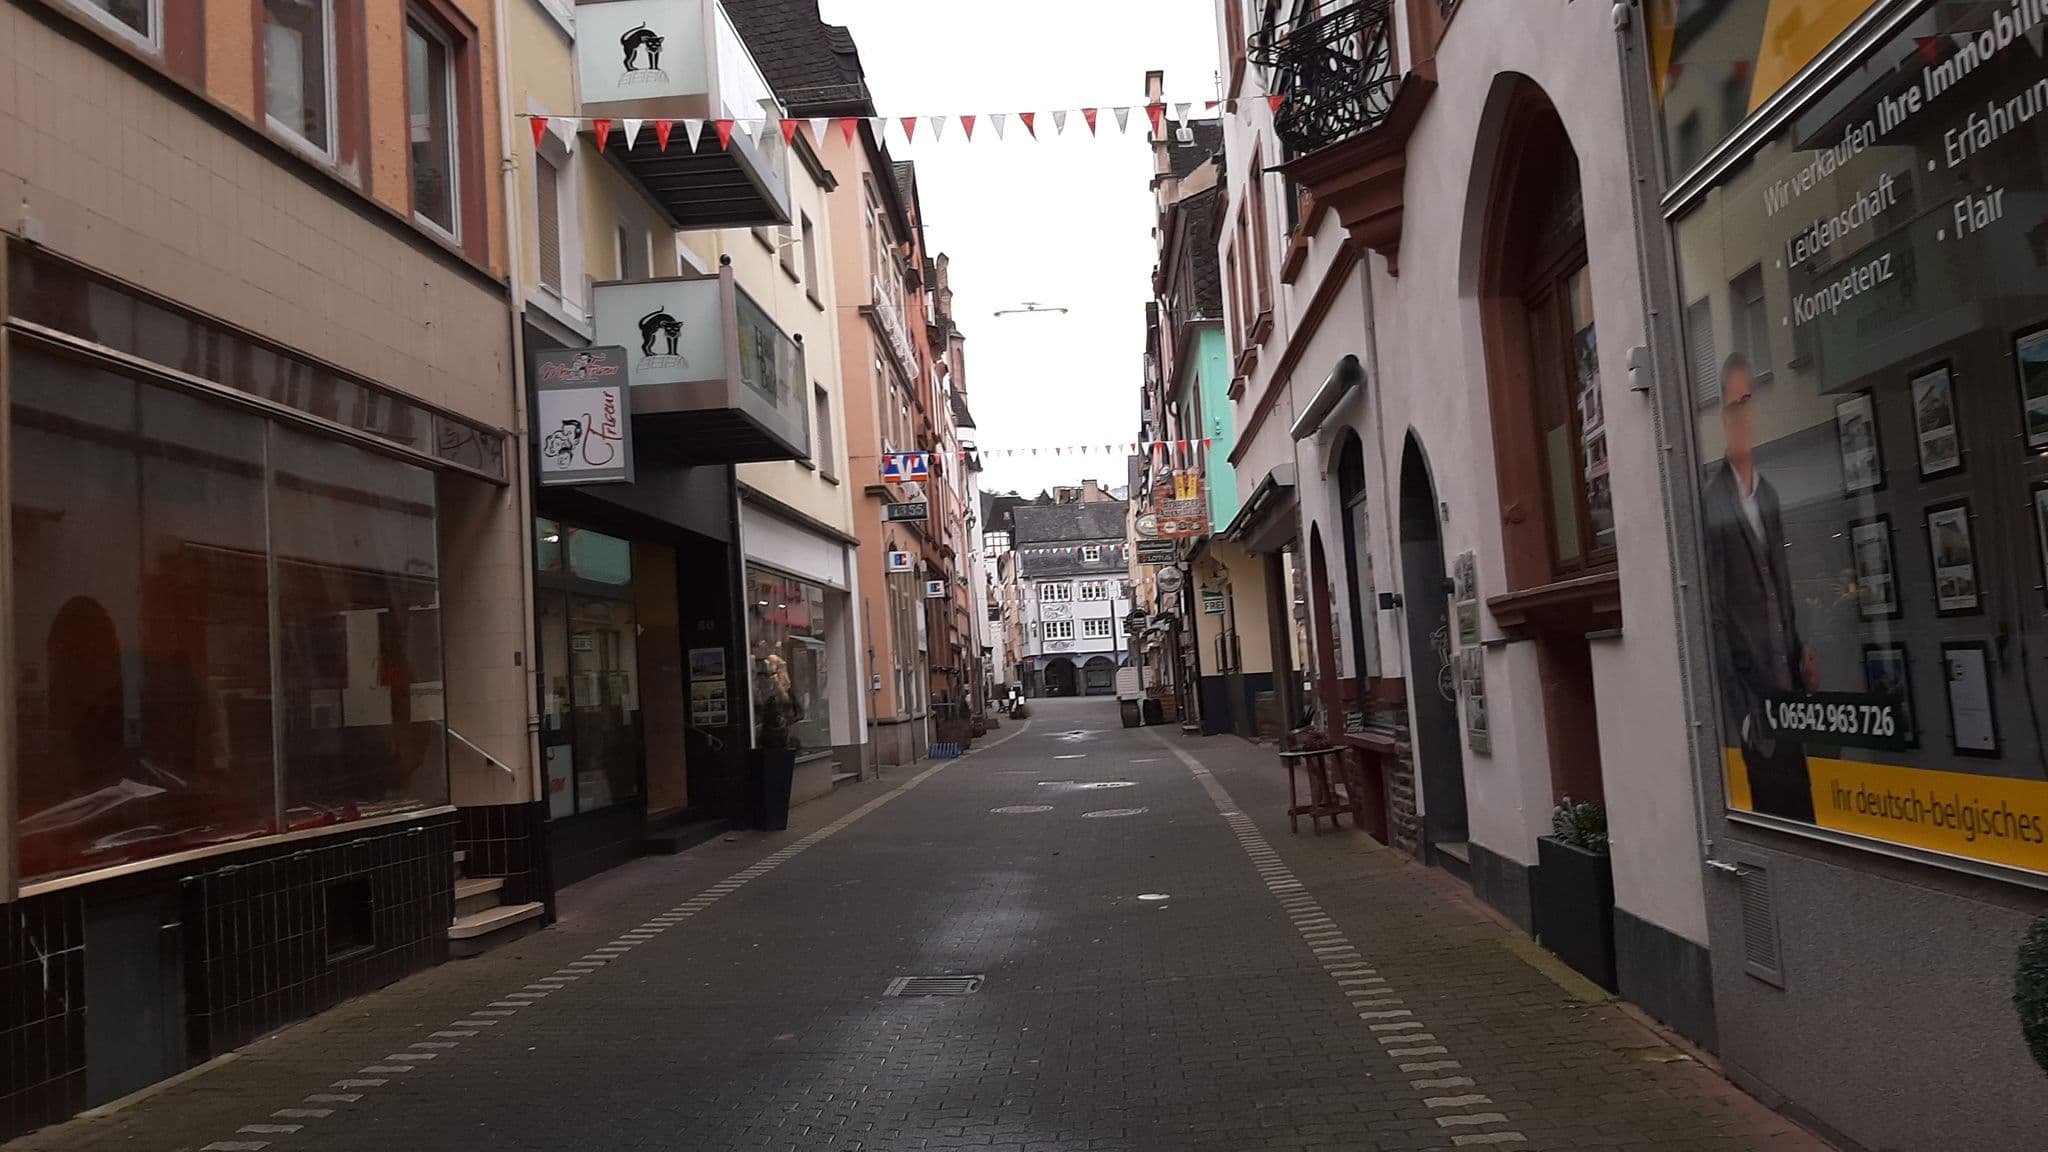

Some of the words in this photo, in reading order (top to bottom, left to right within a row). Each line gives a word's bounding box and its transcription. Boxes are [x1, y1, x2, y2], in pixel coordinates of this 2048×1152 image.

[1763, 179, 1790, 217] Wir
[1791, 119, 1877, 197] verkaufen
[1877, 86, 1922, 136] Ihre
[1923, 0, 2048, 102] Immobili
[1786, 172, 1897, 268] Leidenschaft
[1954, 184, 2005, 239] Flair
[1792, 252, 1895, 327] Kompetenz
[1778, 701, 1826, 731] 06542
[1827, 703, 1859, 734] 963
[1860, 705, 1895, 737] 726
[1830, 779, 1853, 811] Ihr
[1856, 781, 2044, 844] deutsch-belgisches
